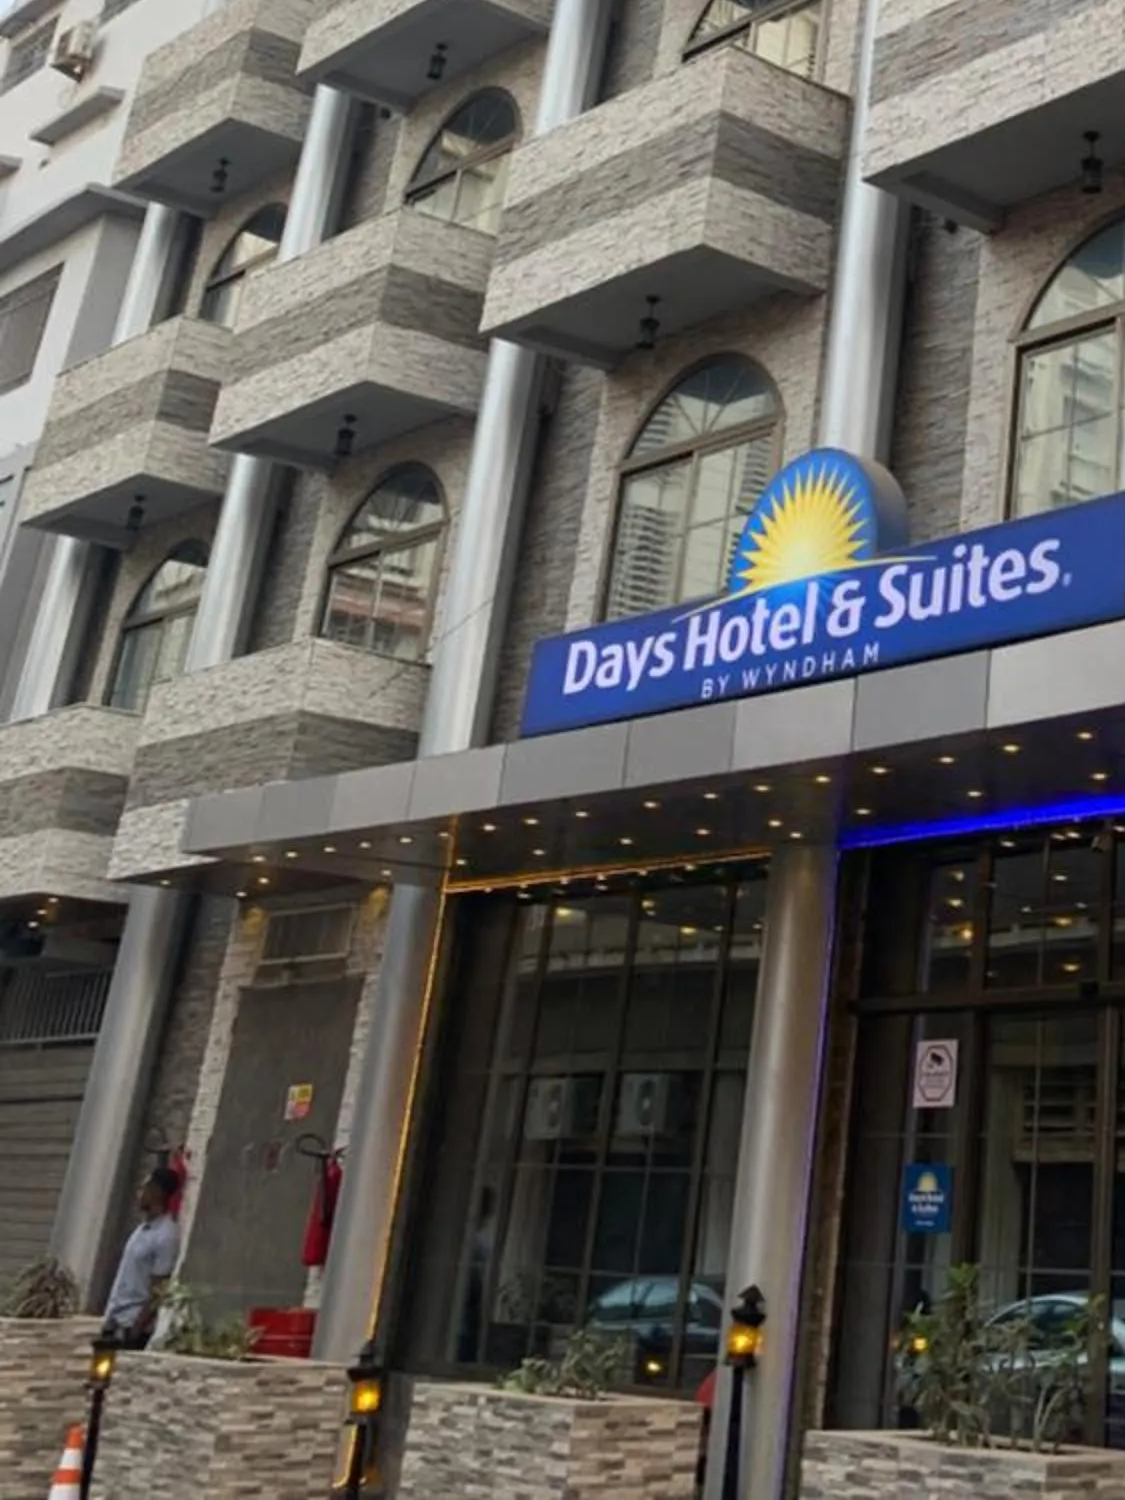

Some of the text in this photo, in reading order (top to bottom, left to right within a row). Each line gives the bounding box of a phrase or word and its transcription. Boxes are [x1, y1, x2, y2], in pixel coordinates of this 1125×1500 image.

[563, 538, 1061, 694] Days Hotel & Suites
[701, 641, 880, 700] BY WYNDHAM
